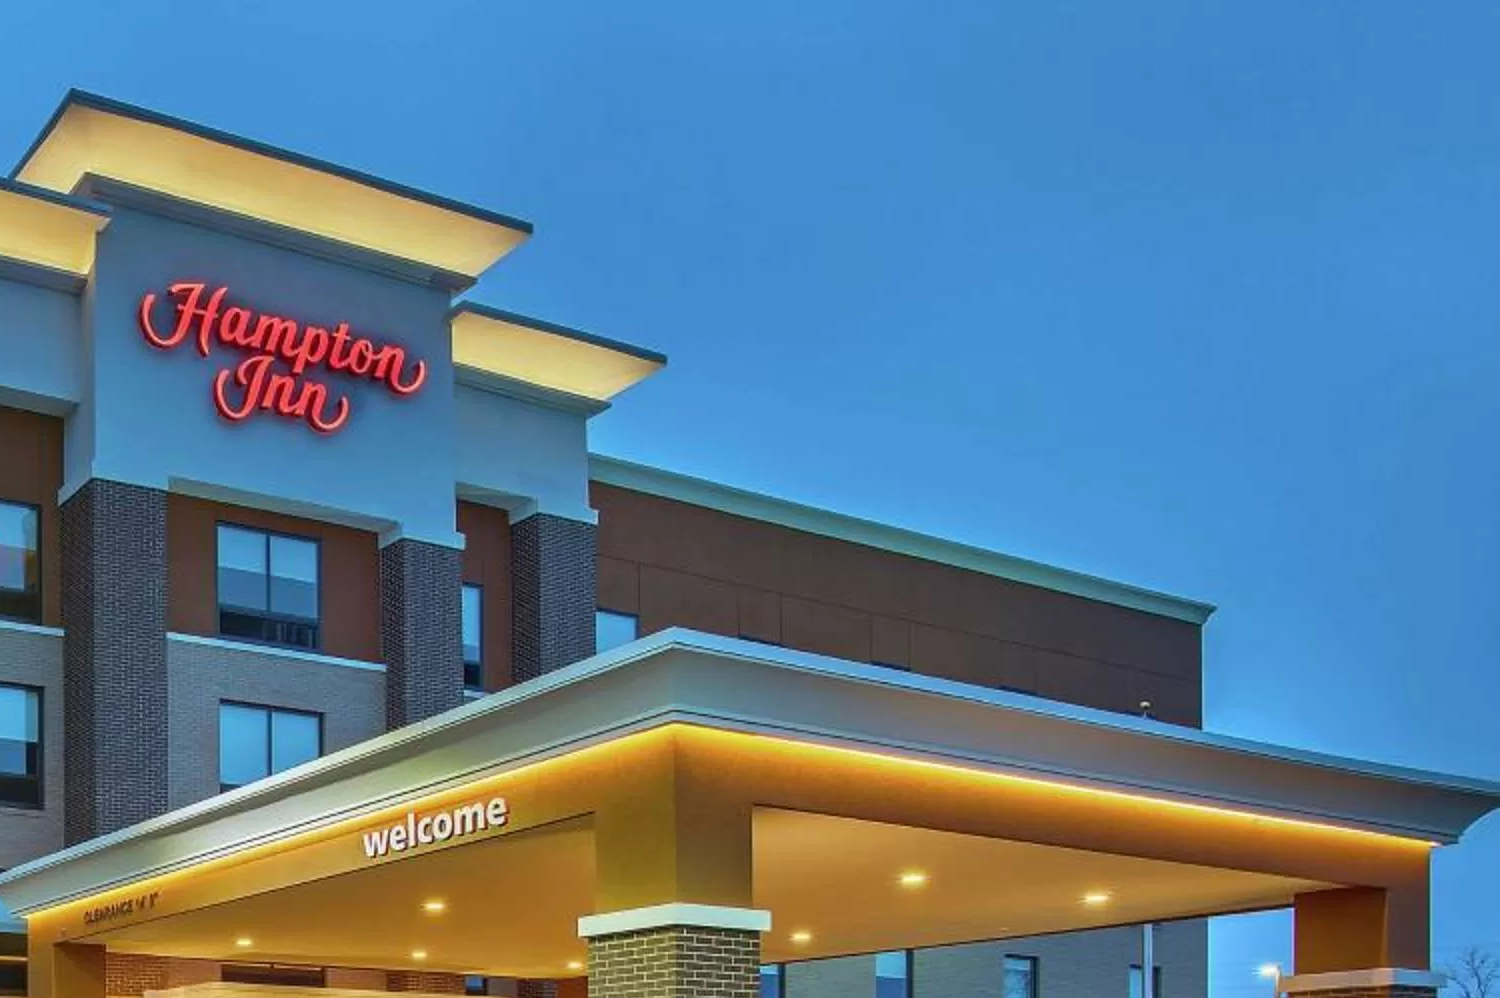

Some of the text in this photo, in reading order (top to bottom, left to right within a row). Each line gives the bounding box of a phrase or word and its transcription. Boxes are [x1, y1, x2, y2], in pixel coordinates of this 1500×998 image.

[138, 279, 427, 396] Hampton
[212, 355, 349, 435] Inn
[363, 797, 508, 857] welcome
